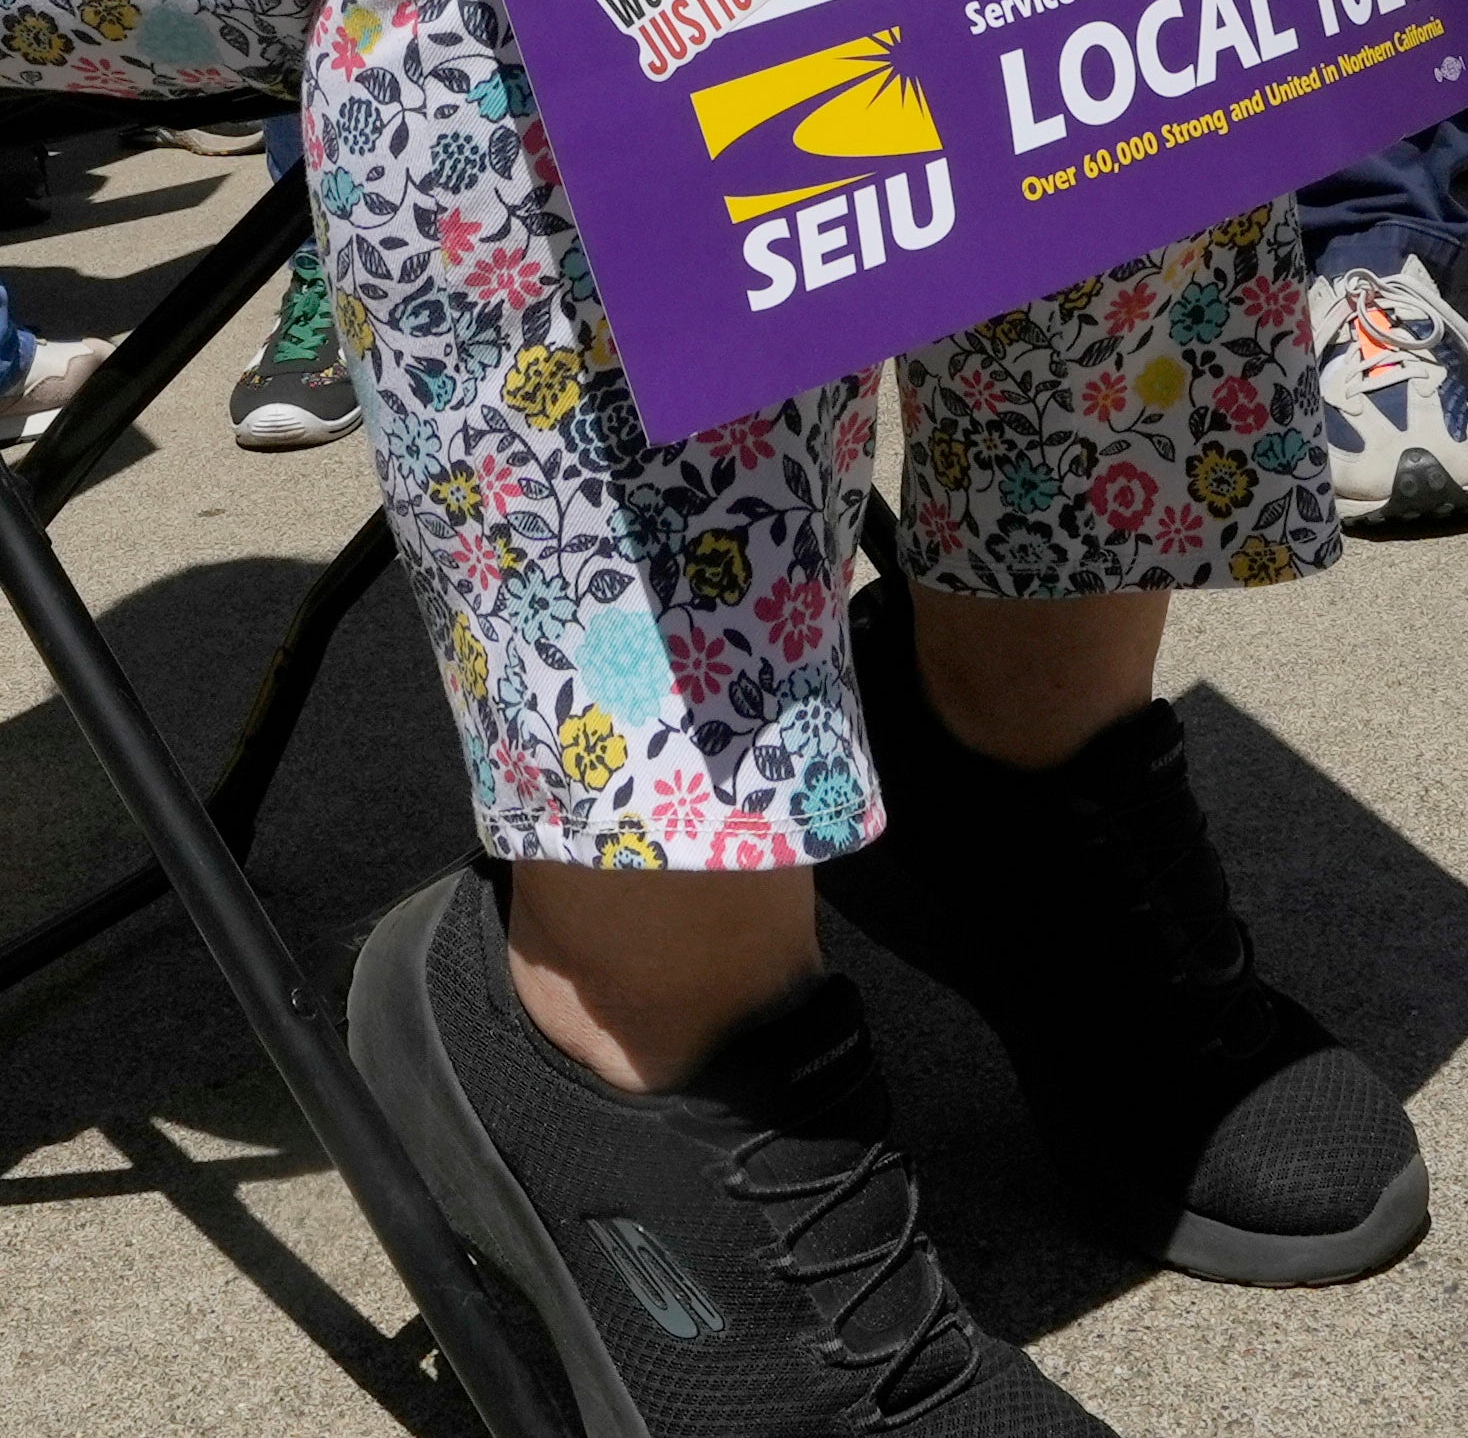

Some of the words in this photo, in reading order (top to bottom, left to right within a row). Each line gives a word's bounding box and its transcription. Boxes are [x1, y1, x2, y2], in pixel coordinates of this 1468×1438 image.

[1021, 165, 1077, 202] Over
[1083, 131, 1159, 174] 60,000
[1160, 107, 1230, 150] Strong
[1229, 89, 1266, 123] and
[1265, 67, 1323, 107] United
[1320, 62, 1339, 85] in
[1337, 39, 1396, 77] Northern
[1393, 16, 1445, 53] California
[742, 159, 958, 313] SEIU
